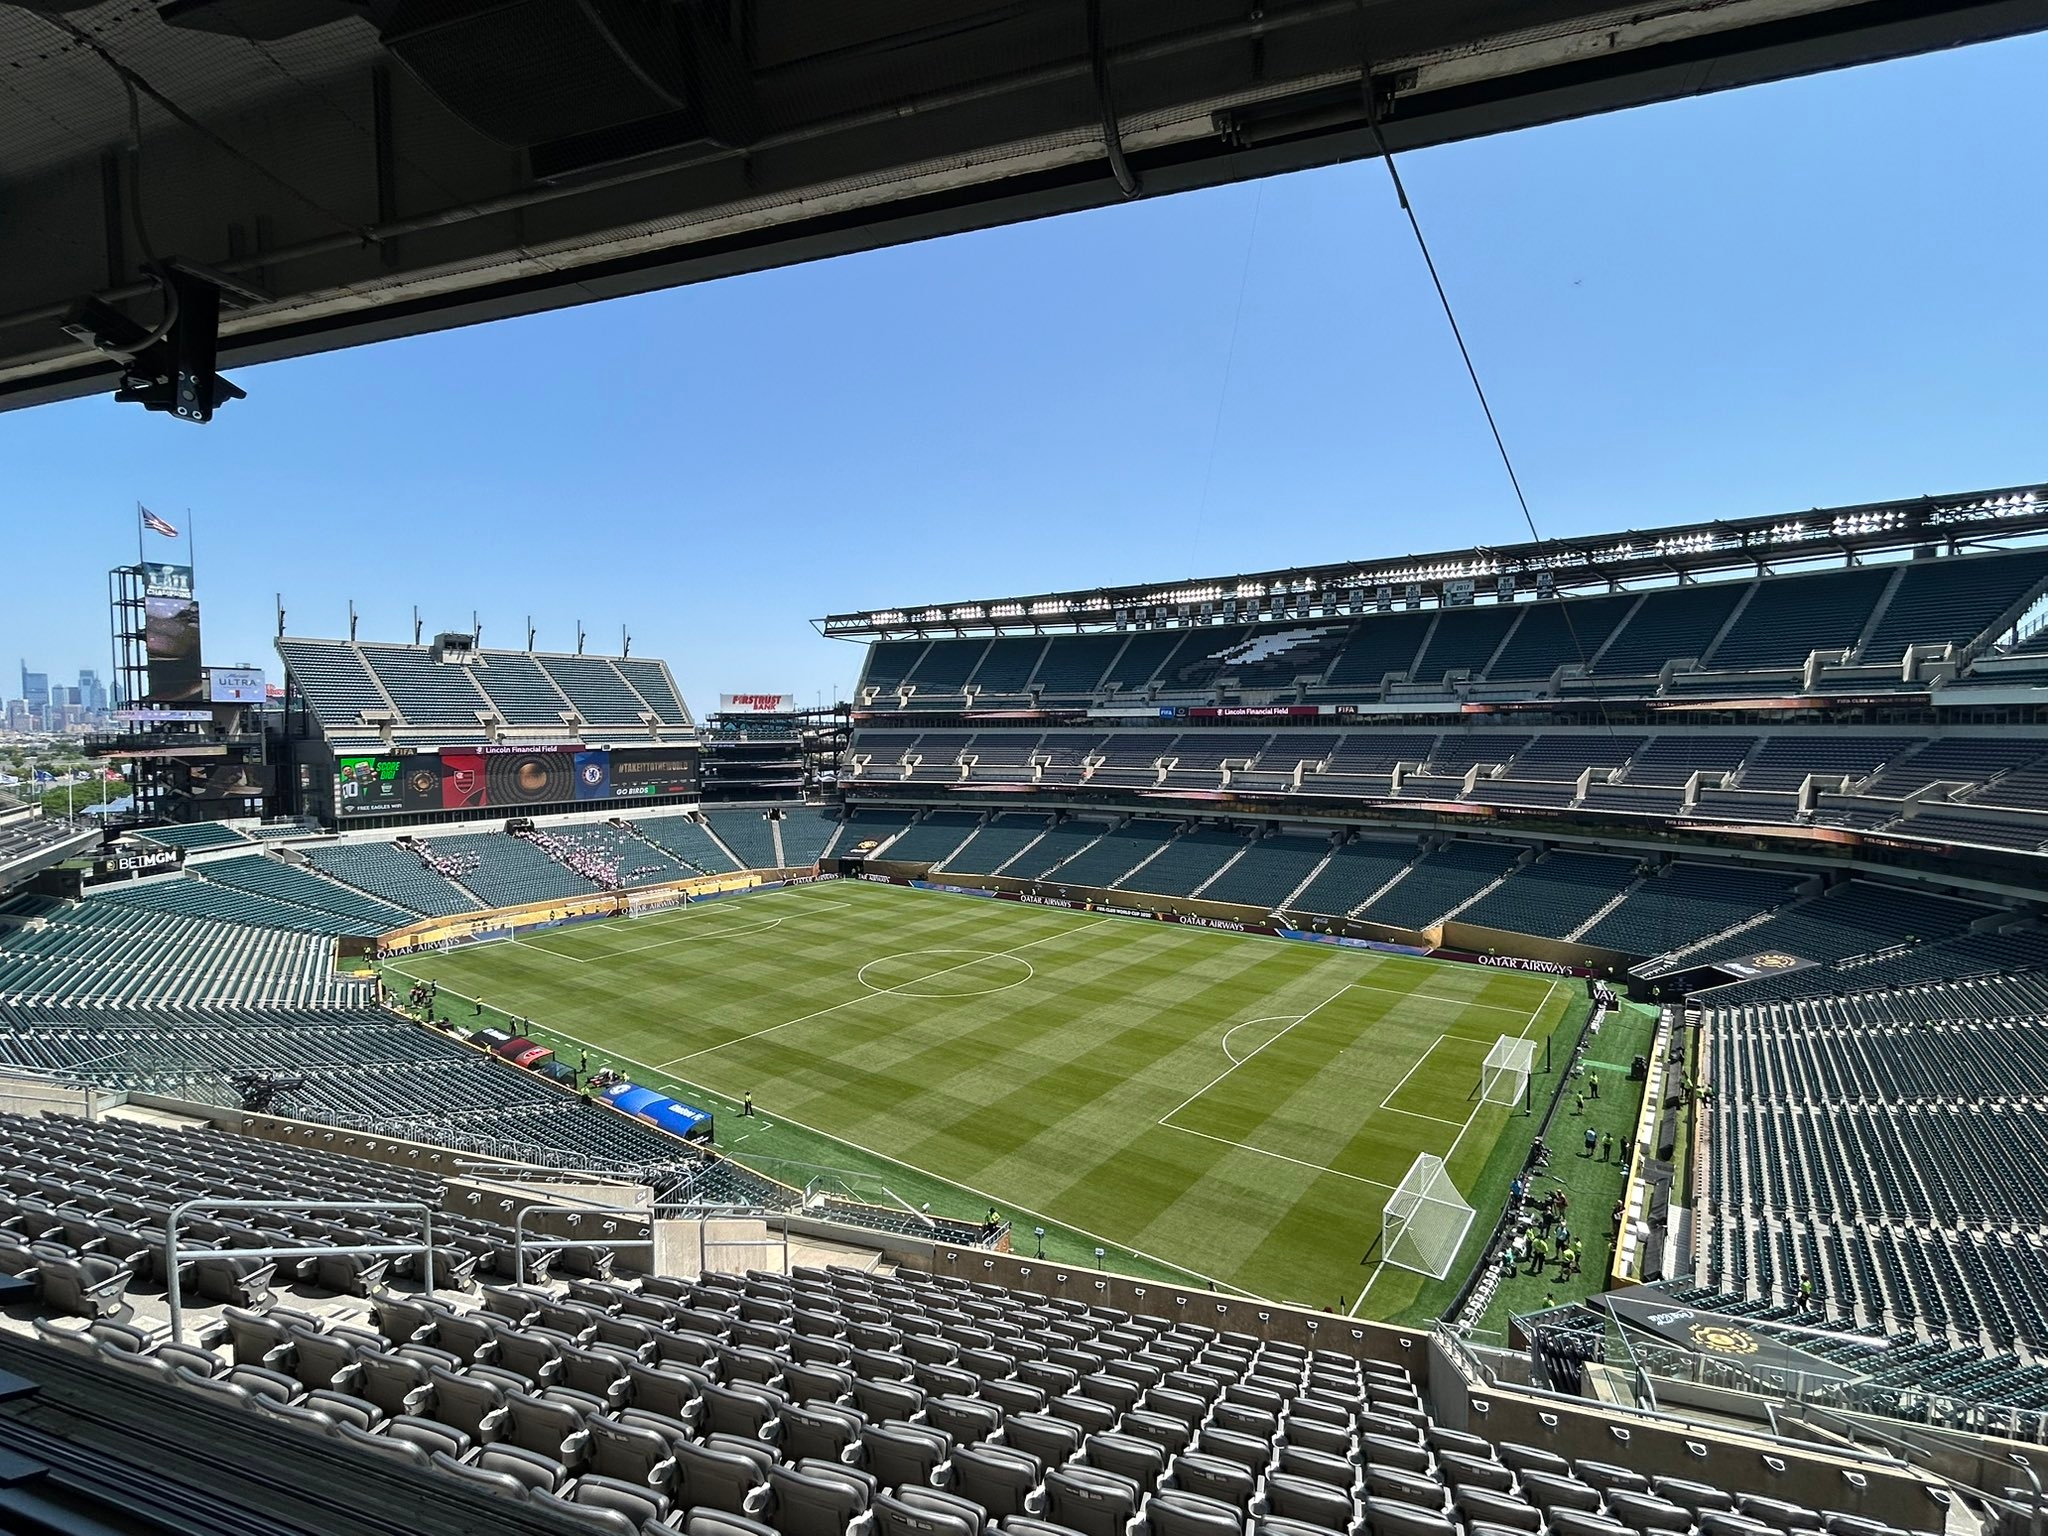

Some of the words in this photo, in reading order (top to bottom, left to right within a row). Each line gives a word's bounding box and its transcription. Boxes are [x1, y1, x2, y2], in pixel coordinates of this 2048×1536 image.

[147, 589, 192, 599] CHAMPIONS
[219, 678, 256, 686] ULTRA
[732, 695, 781, 704] FIRSTRUST
[376, 762, 400, 771] SCORE
[380, 770, 396, 780] BIG!
[629, 787, 648, 795] BIRDS
[119, 851, 177, 870] BETMGM
[792, 876, 813, 886] QATAR
[814, 872, 839, 882] AIRWAYS
[649, 899, 680, 910] AIRWAYS
[1020, 894, 1042, 904] QATAR
[1043, 896, 1072, 908] AIRWAYS
[1179, 915, 1206, 927] QATAR
[1208, 920, 1245, 932] AIRWAYS
[377, 945, 413, 959] QATAR
[417, 937, 460, 952] AIRWAYS
[1478, 955, 1518, 968] QATAR
[1521, 962, 1573, 975] AIRWAYS
